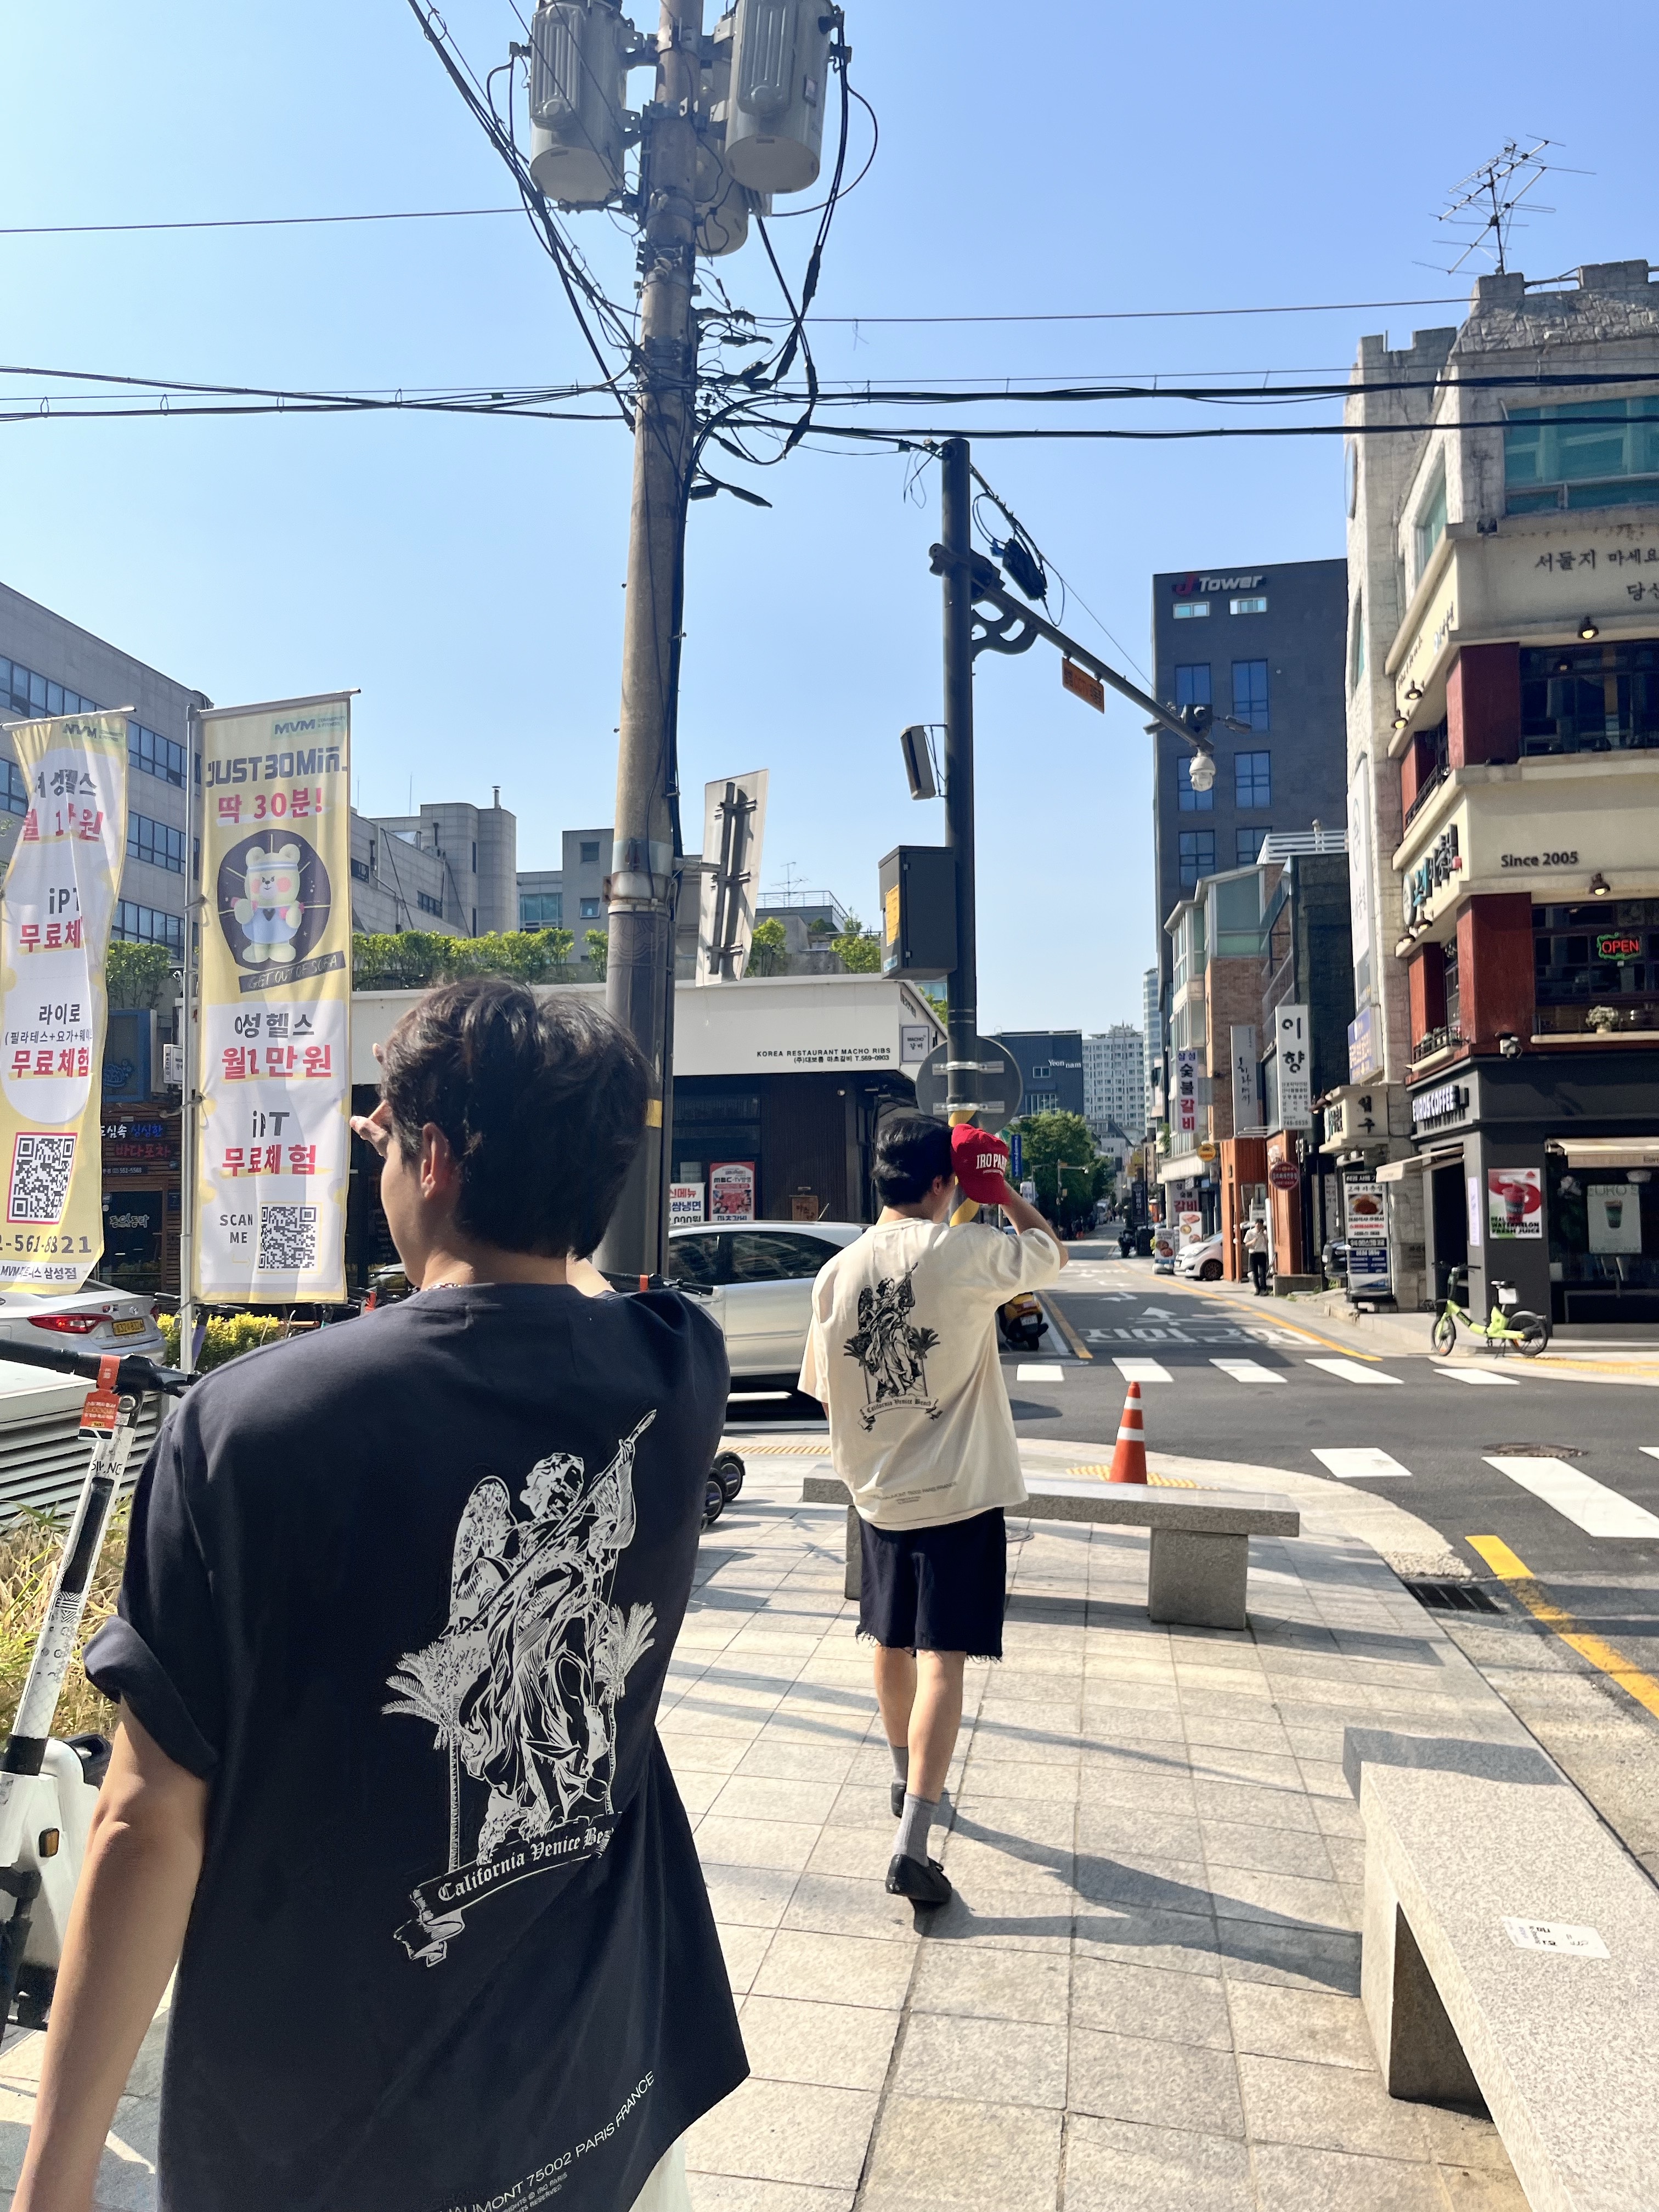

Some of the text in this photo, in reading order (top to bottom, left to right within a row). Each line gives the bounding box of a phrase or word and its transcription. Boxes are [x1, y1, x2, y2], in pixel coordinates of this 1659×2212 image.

[1199, 575, 1263, 592] Tower
[275, 719, 316, 735] MVM
[218, 787, 323, 823] 딱 30분!
[1501, 850, 1579, 868] Since 2005
[1601, 939, 1640, 955] OPEN
[39, 1003, 81, 1025] 라이로
[12, 1046, 90, 1079] 무료체험
[976, 1153, 992, 1169] IRO
[219, 1214, 253, 1227] SCAN
[229, 1231, 249, 1244] ME
[44, 1267, 77, 1279] 삼성점
[438, 1852, 526, 1903] California
[530, 1836, 581, 1861] Venice
[526, 2151, 572, 2187] 75002
[575, 2121, 615, 2158] PARIS
[615, 2070, 654, 2128] FRANCE
[537, 2185, 549, 2195] IRO
